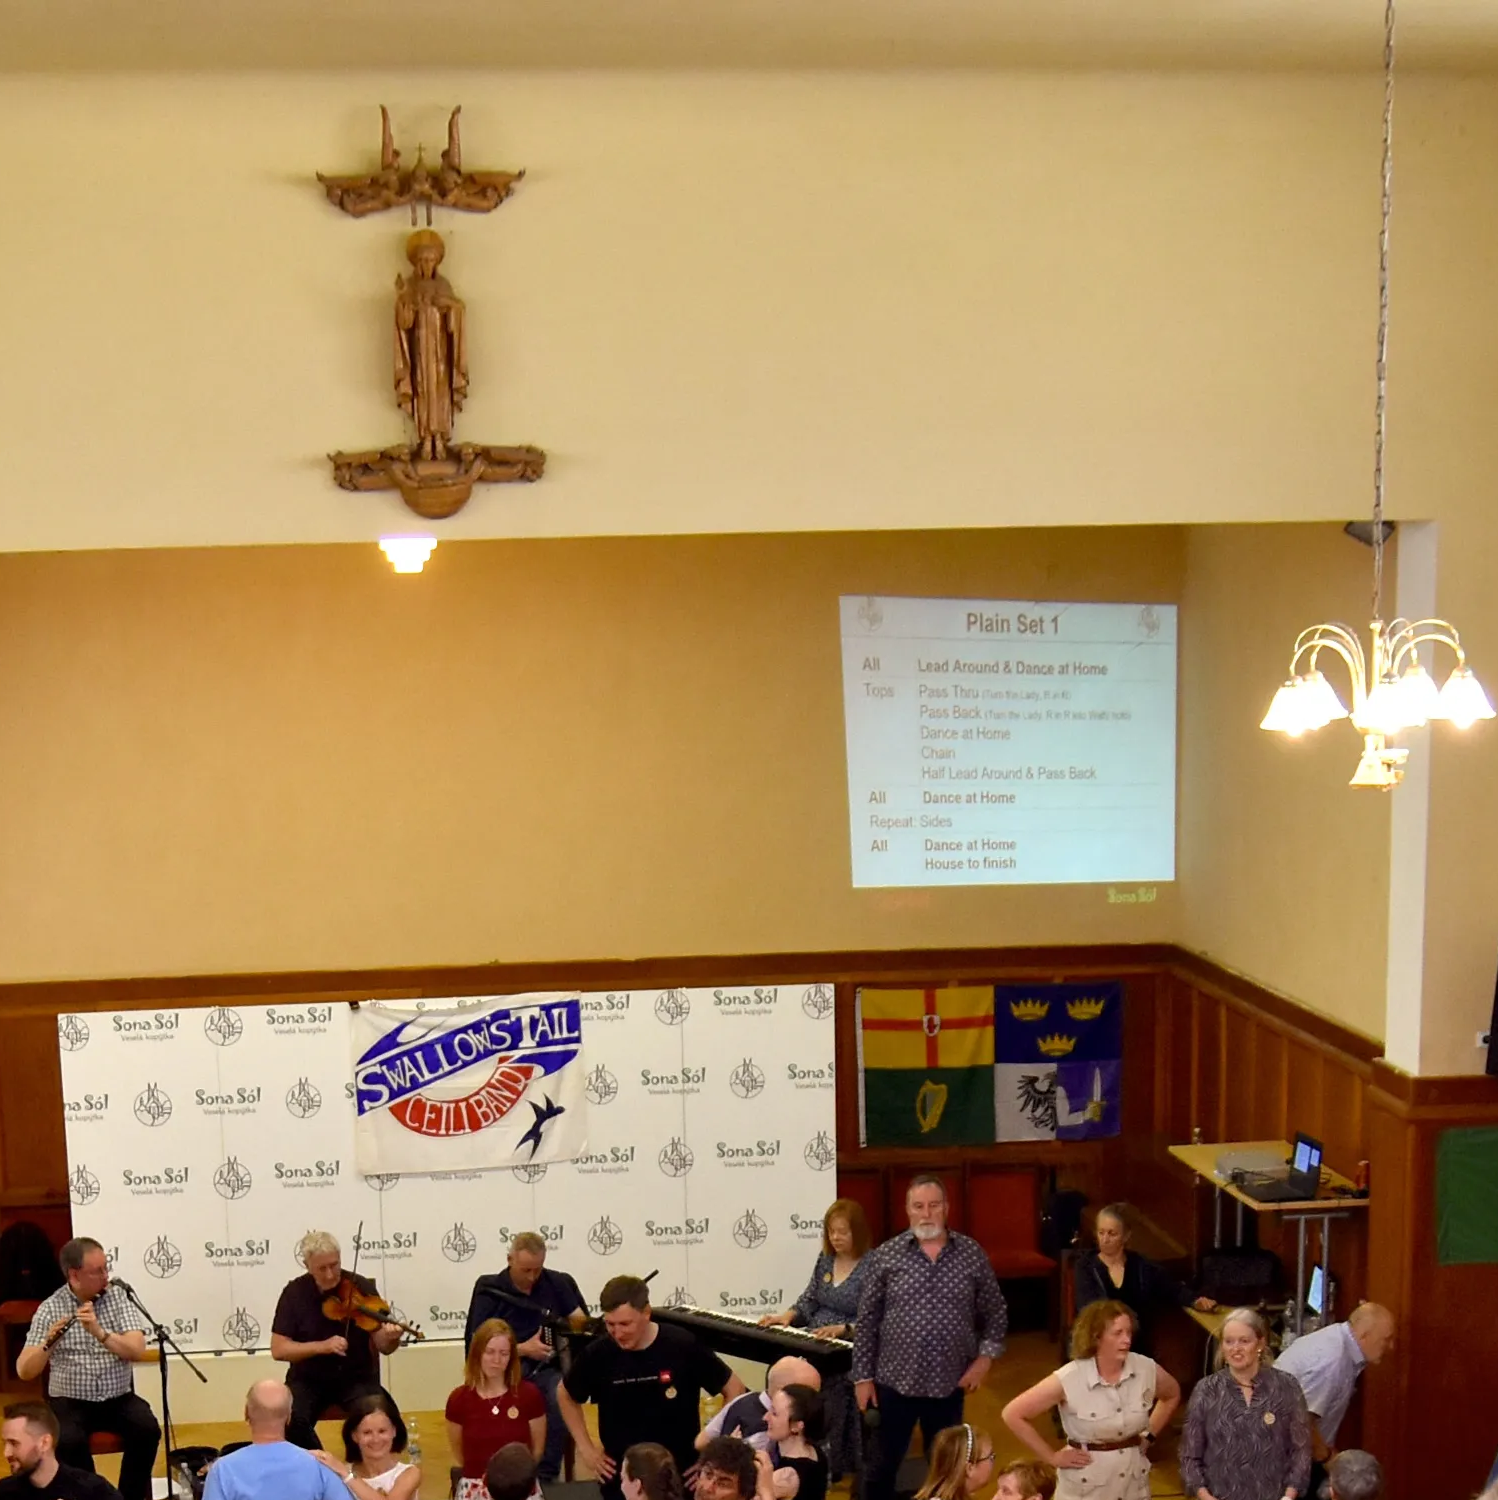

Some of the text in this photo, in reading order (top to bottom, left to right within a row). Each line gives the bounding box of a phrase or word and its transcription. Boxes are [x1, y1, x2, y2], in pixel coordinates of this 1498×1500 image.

[966, 612, 1059, 635] Plain Set 1
[862, 657, 1108, 676] All Lead Around & Dance at Home
[864, 682, 895, 699] Tops
[918, 684, 949, 698] Pass
[952, 684, 979, 699] Thru
[920, 704, 950, 719] Pass
[952, 705, 983, 720] Back
[920, 725, 1011, 740] Dance at Home
[921, 745, 956, 759] Chain
[922, 766, 1097, 780] Half Lead Around & Pass Back
[869, 791, 1016, 804] All Dance at Home
[870, 814, 953, 830] Repeat: Sides
[871, 838, 1017, 852] All Dance at Home
[925, 856, 1017, 870] House to finish
[581, 994, 630, 1011] na Sól
[713, 988, 778, 1006] Sona Sól
[112, 1012, 179, 1032] Sona Sól
[266, 1006, 333, 1026] Sona Sól
[510, 1006, 580, 1049] TAIL
[640, 1067, 706, 1086] Sona Sól
[787, 1063, 825, 1080] Sona
[64, 1094, 109, 1111] na Sól
[195, 1087, 261, 1106] Sona Sól
[405, 1066, 527, 1135] CEILI BAND
[610, 1146, 635, 1164] Sól
[716, 1140, 781, 1159] Sona Sól
[122, 1167, 189, 1186] Sona Sól
[274, 1161, 340, 1180] Sona Sól
[539, 1224, 564, 1241] Sól
[645, 1218, 709, 1237] Sona Sól
[204, 1239, 270, 1258] Sona Sól
[352, 1231, 417, 1251] Sona Sól
[106, 1246, 119, 1264] ól
[719, 1289, 783, 1307] Sona Sól
[173, 1318, 198, 1335] Sól
